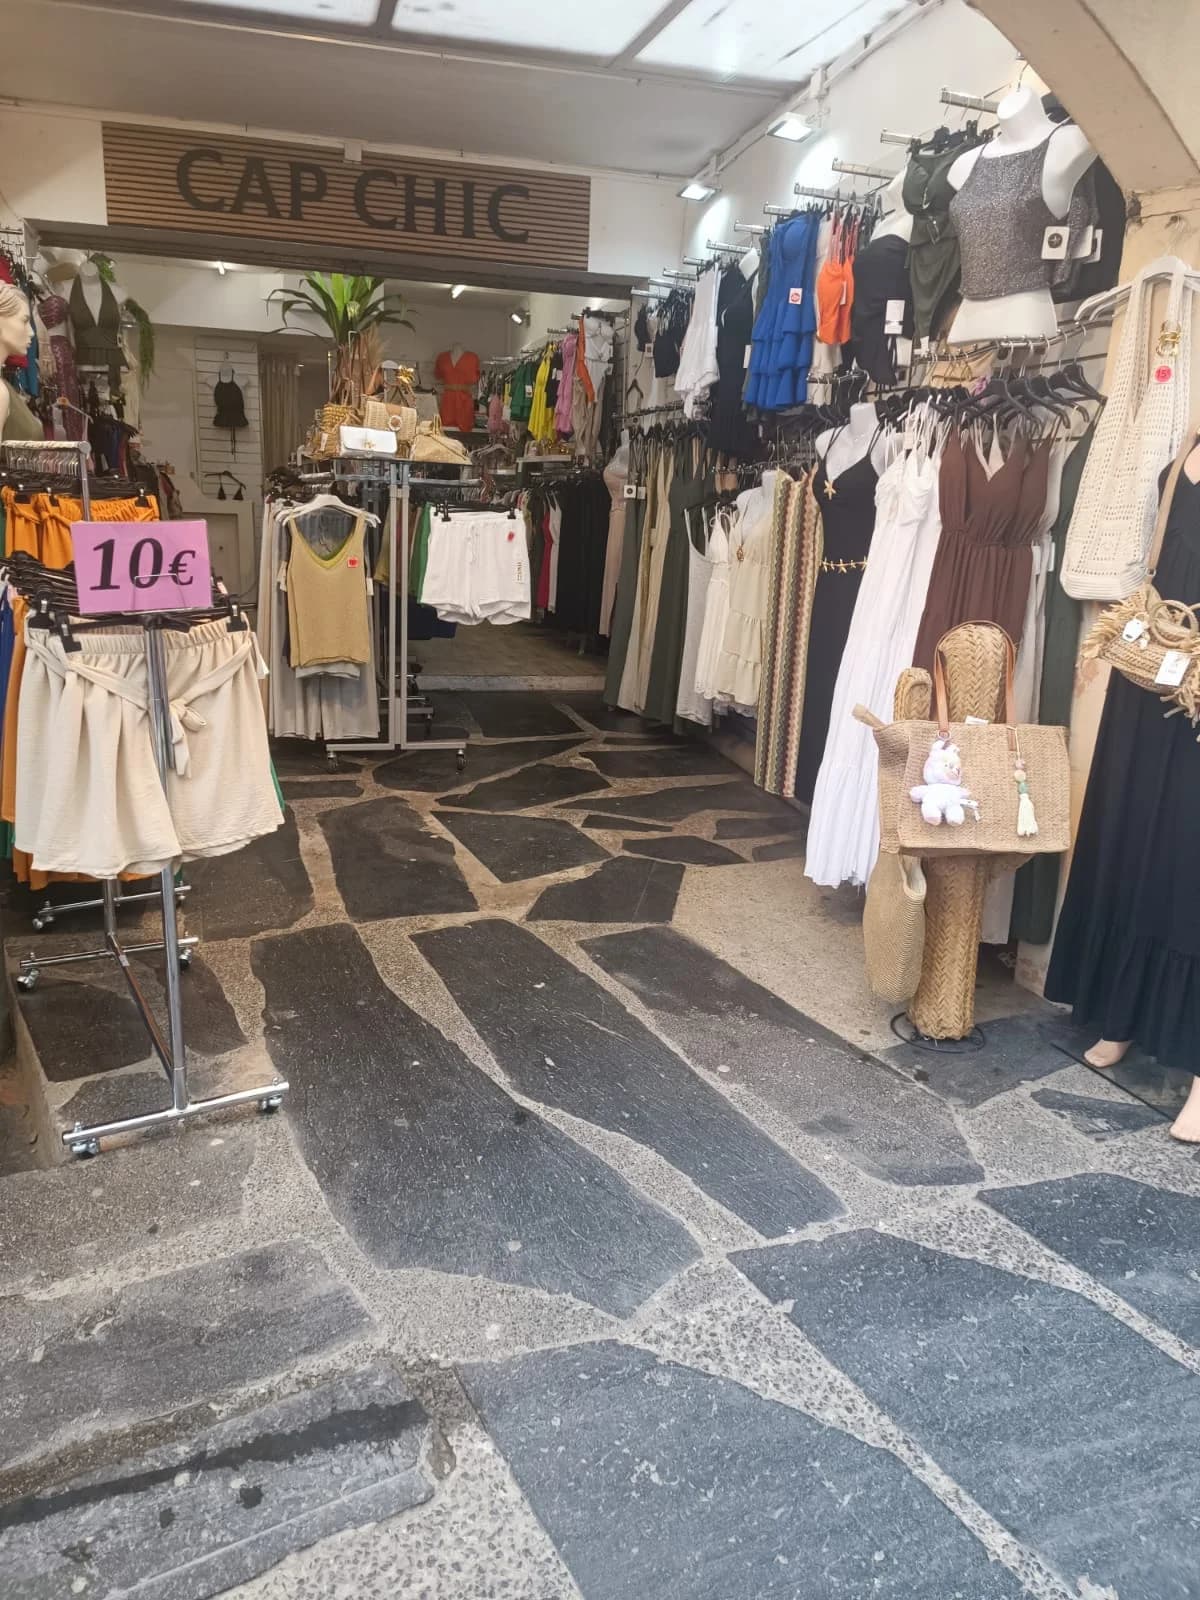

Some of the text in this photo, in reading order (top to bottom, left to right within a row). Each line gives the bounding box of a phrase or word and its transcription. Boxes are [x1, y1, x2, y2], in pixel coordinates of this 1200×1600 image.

[176, 149, 530, 243] CAP CHIC
[89, 537, 196, 591] 10€
